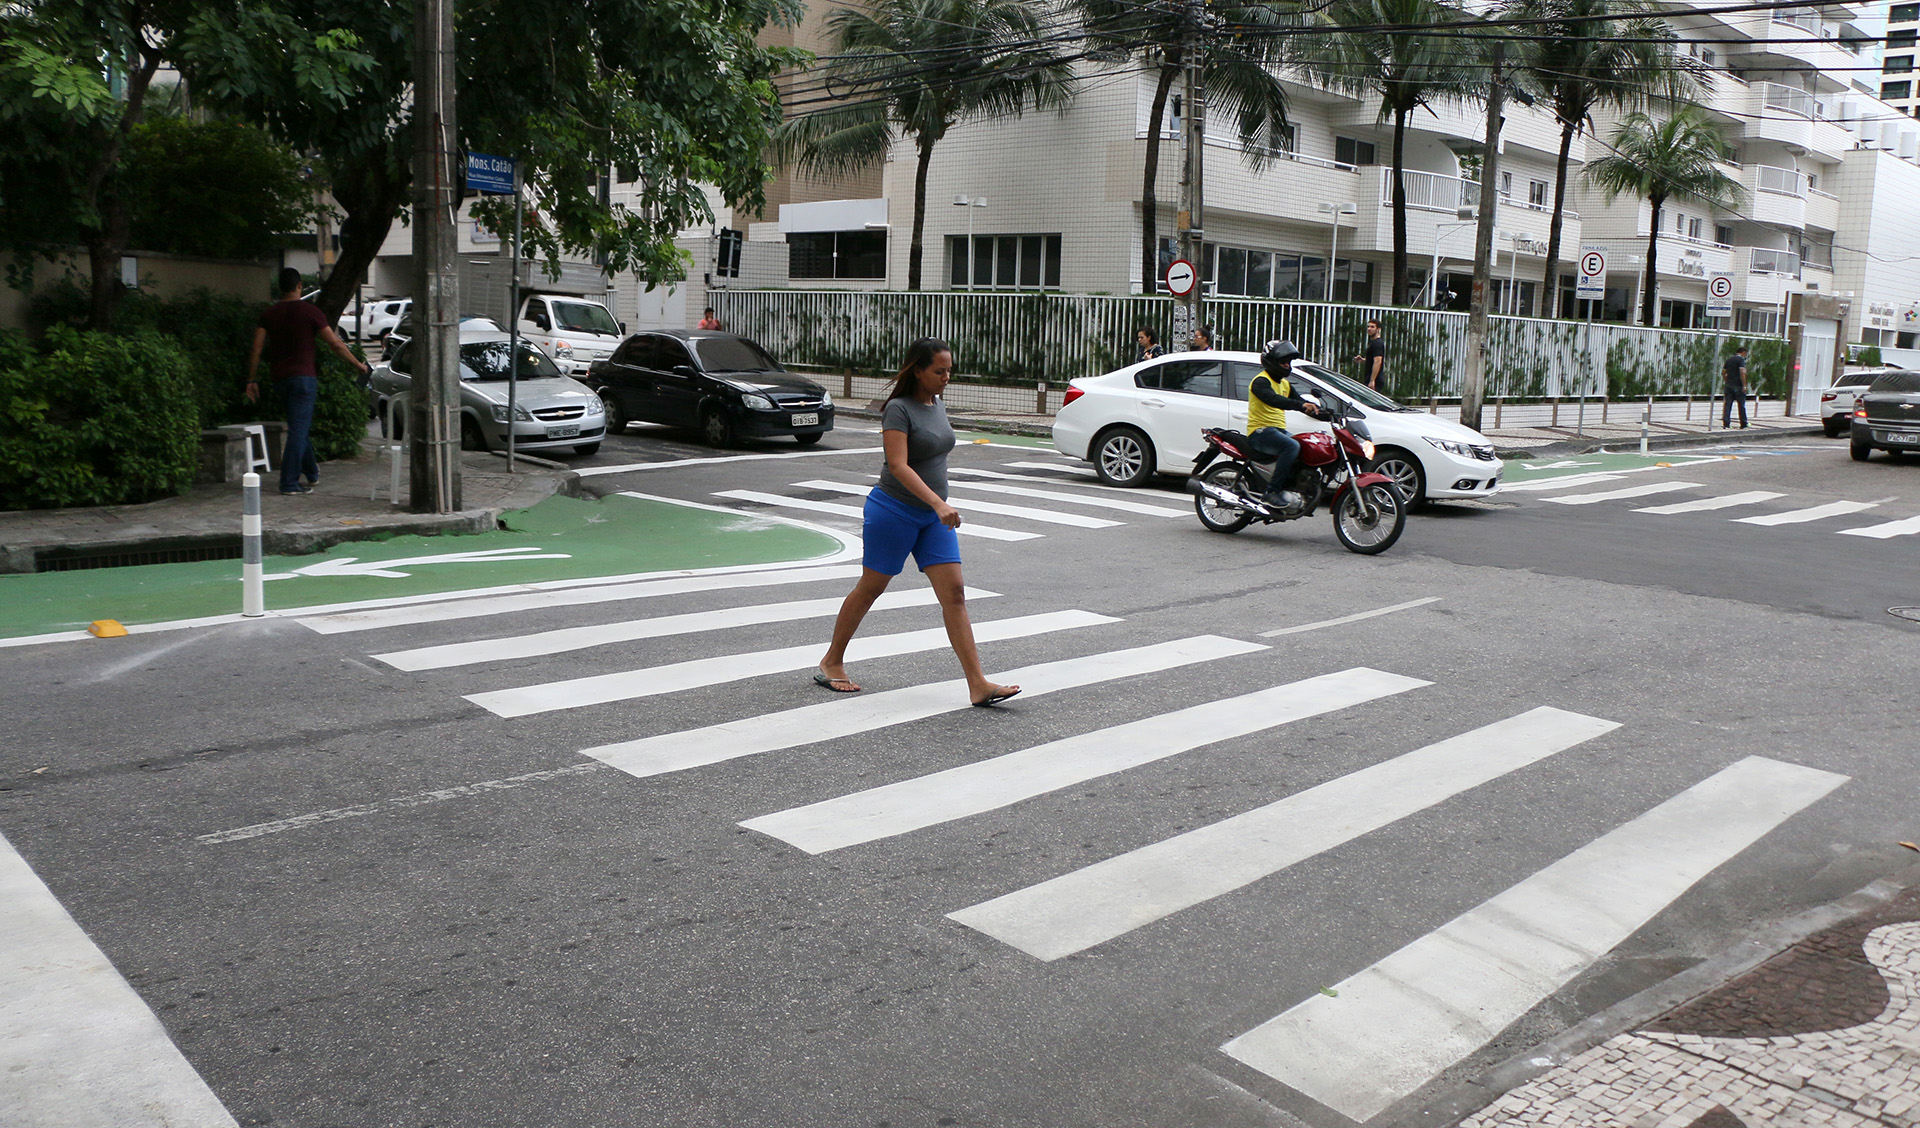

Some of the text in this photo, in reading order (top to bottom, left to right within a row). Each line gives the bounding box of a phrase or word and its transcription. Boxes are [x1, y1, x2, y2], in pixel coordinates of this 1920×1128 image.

[468, 155, 512, 173] Mons. Catão
[1588, 257, 1597, 271] E
[1716, 281, 1725, 293] E
